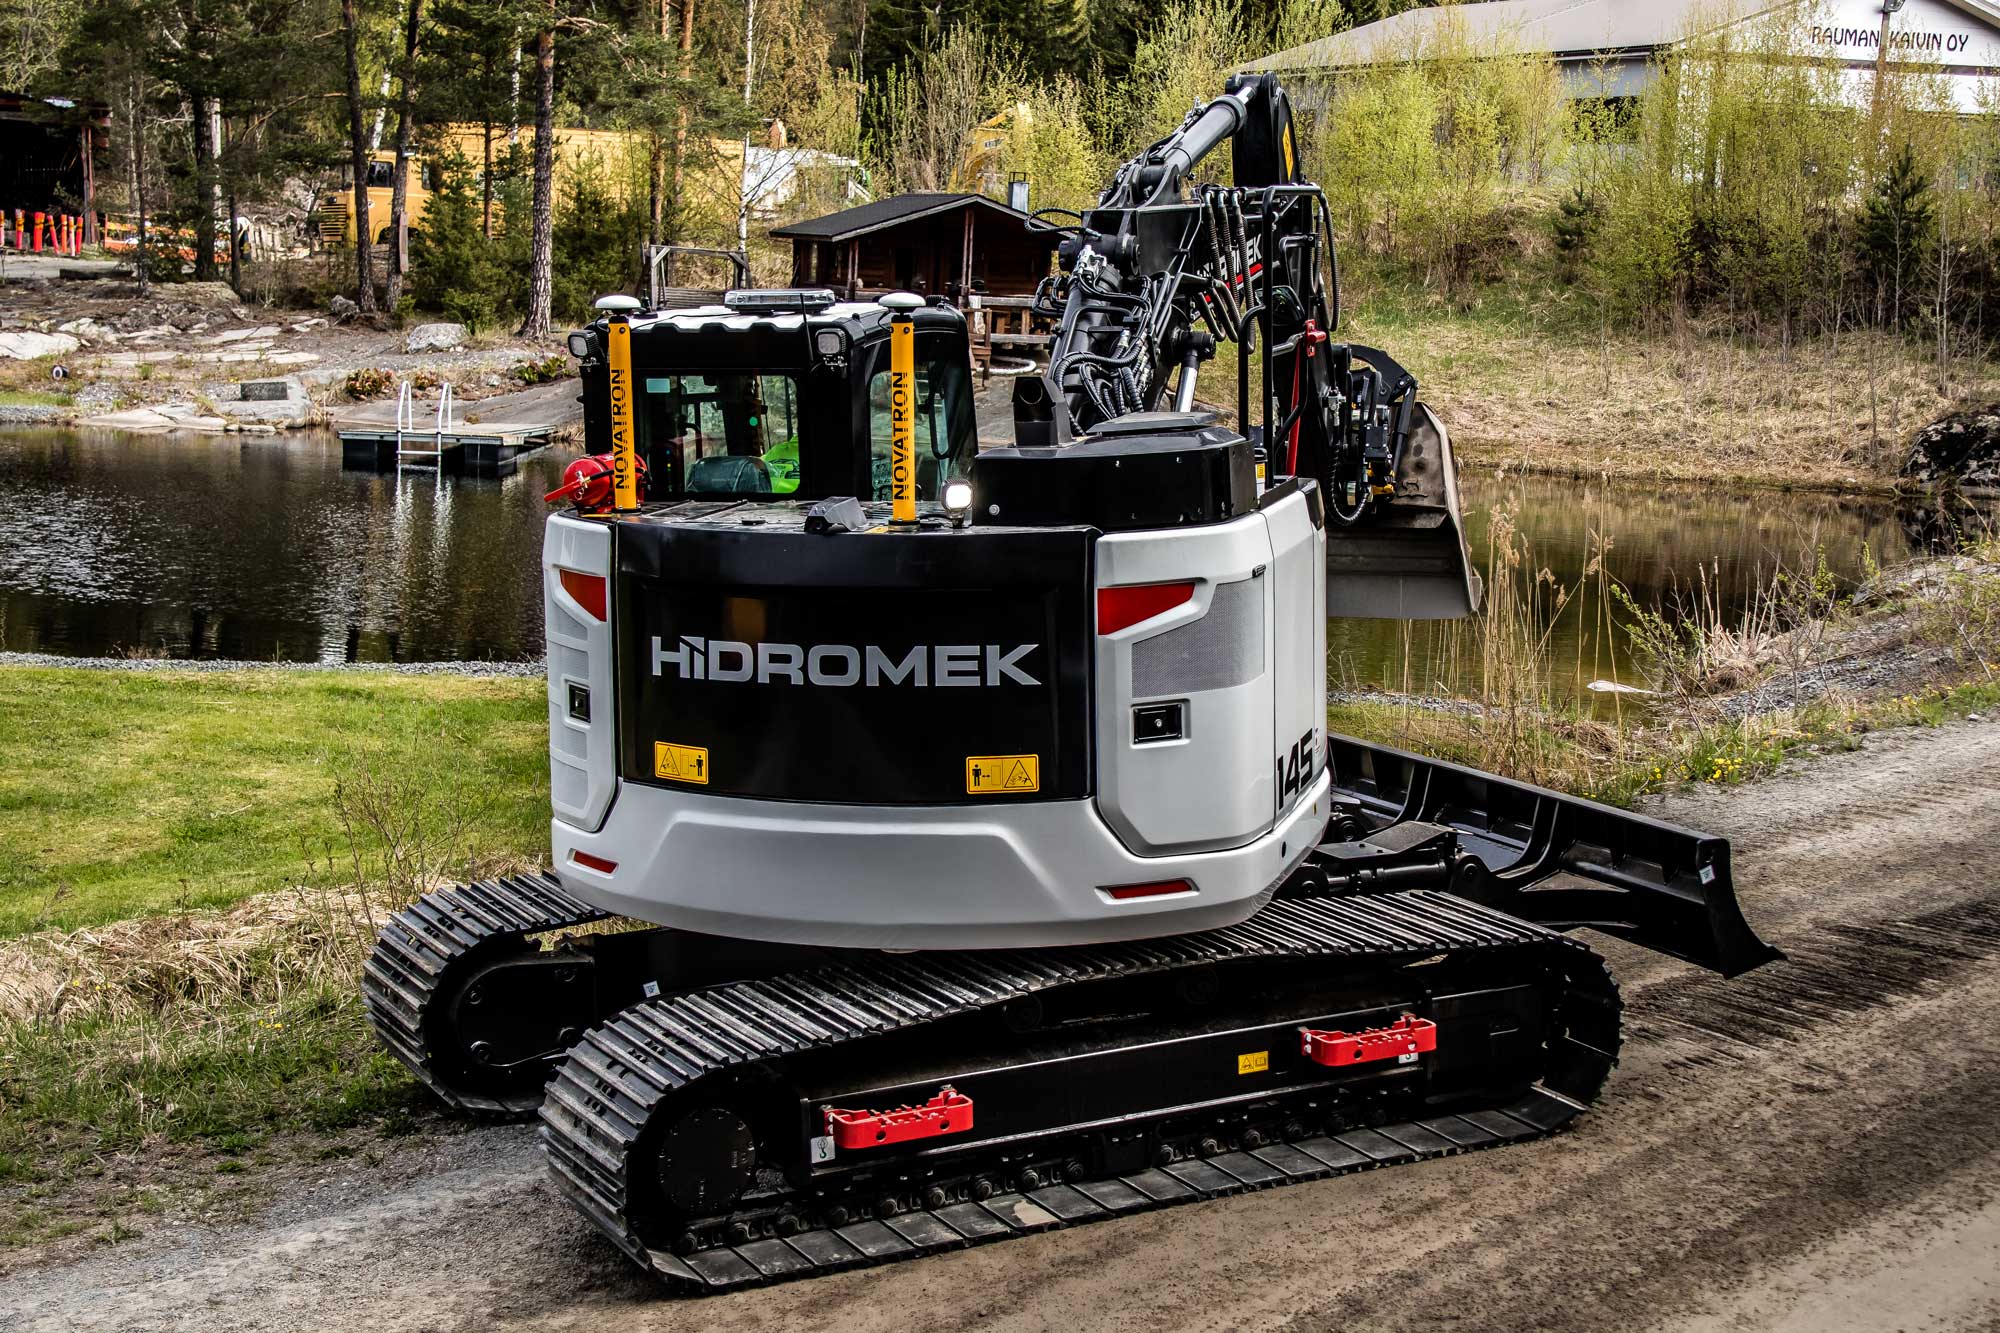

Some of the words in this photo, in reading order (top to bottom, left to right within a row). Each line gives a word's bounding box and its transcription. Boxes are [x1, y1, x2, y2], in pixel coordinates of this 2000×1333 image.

[1811, 26, 1880, 48] RAUMAN
[1946, 34, 1969, 52] OY
[611, 369, 629, 489] NOVATRON
[892, 372, 908, 500] NOVATRON
[1277, 727, 1313, 811] 145
